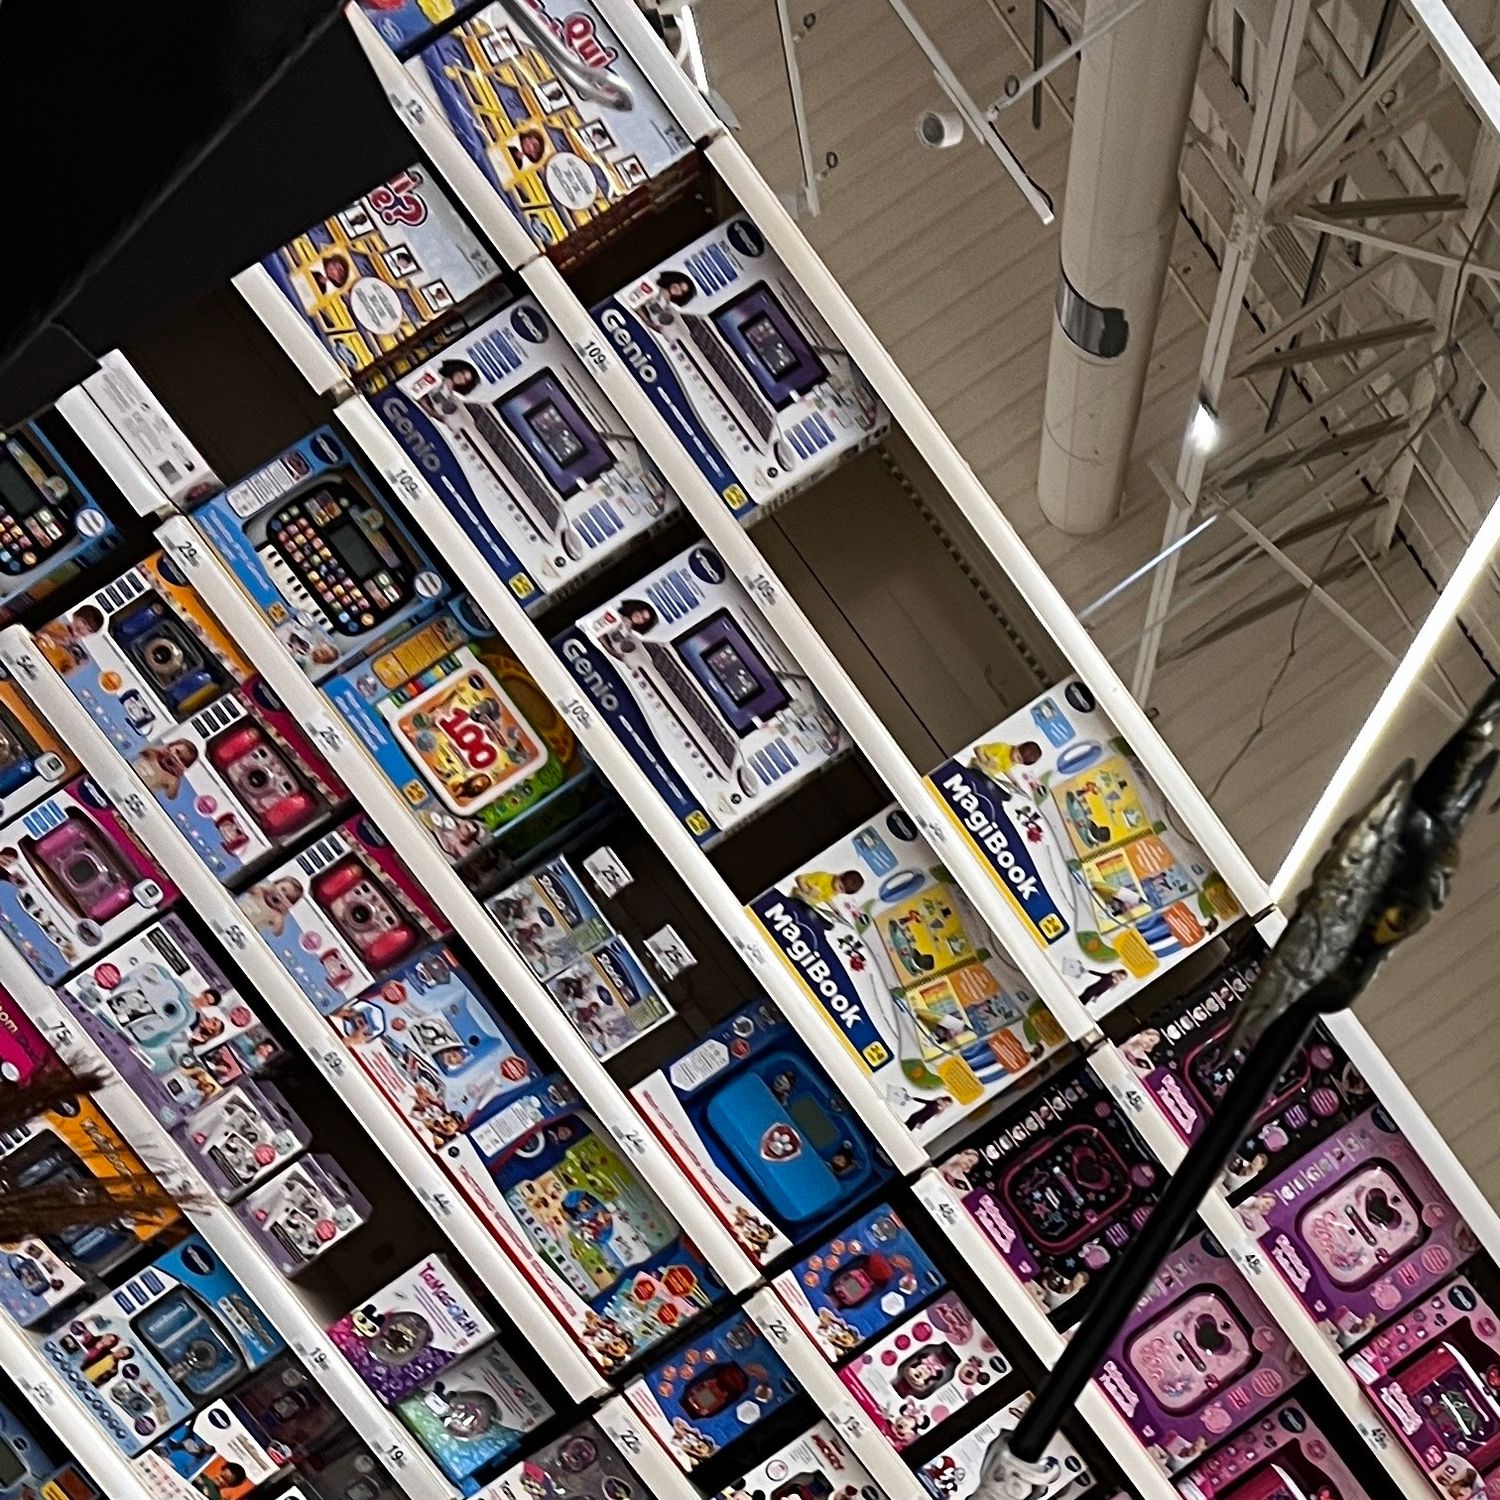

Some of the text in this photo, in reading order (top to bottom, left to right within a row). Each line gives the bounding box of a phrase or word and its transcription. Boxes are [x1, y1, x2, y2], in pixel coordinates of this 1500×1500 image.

[582, 339, 607, 367] 109
[597, 305, 664, 385] Genio
[380, 394, 447, 474] Genio
[394, 466, 418, 494] 109
[559, 635, 625, 714] Genio
[566, 697, 590, 725] 109
[436, 704, 502, 774] 100
[940, 772, 1042, 902] MagiBook
[761, 901, 865, 1031] MagiBook
